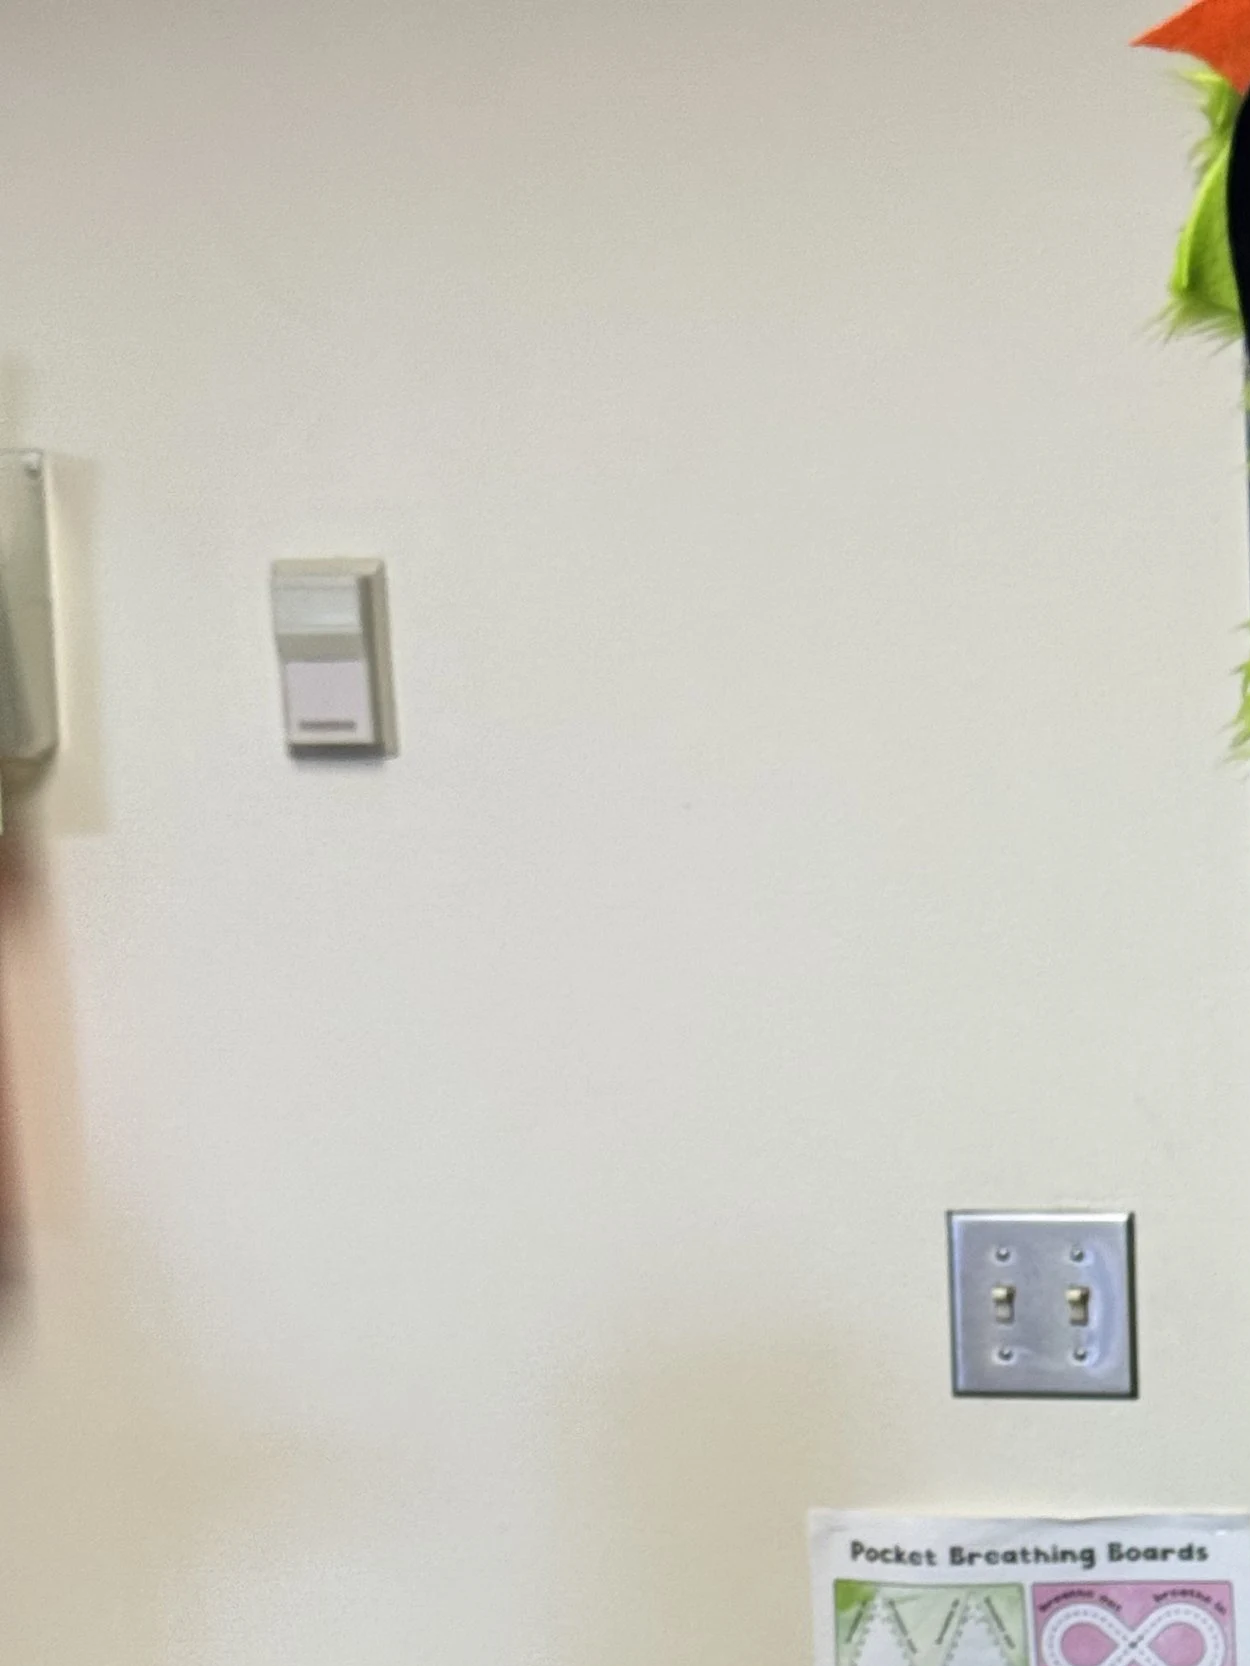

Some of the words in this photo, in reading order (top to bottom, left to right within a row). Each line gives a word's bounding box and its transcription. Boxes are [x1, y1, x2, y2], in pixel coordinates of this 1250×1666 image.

[850, 1540, 937, 1566] Pocket
[949, 1545, 1096, 1569] Breathing
[1107, 1541, 1209, 1562] Boards
